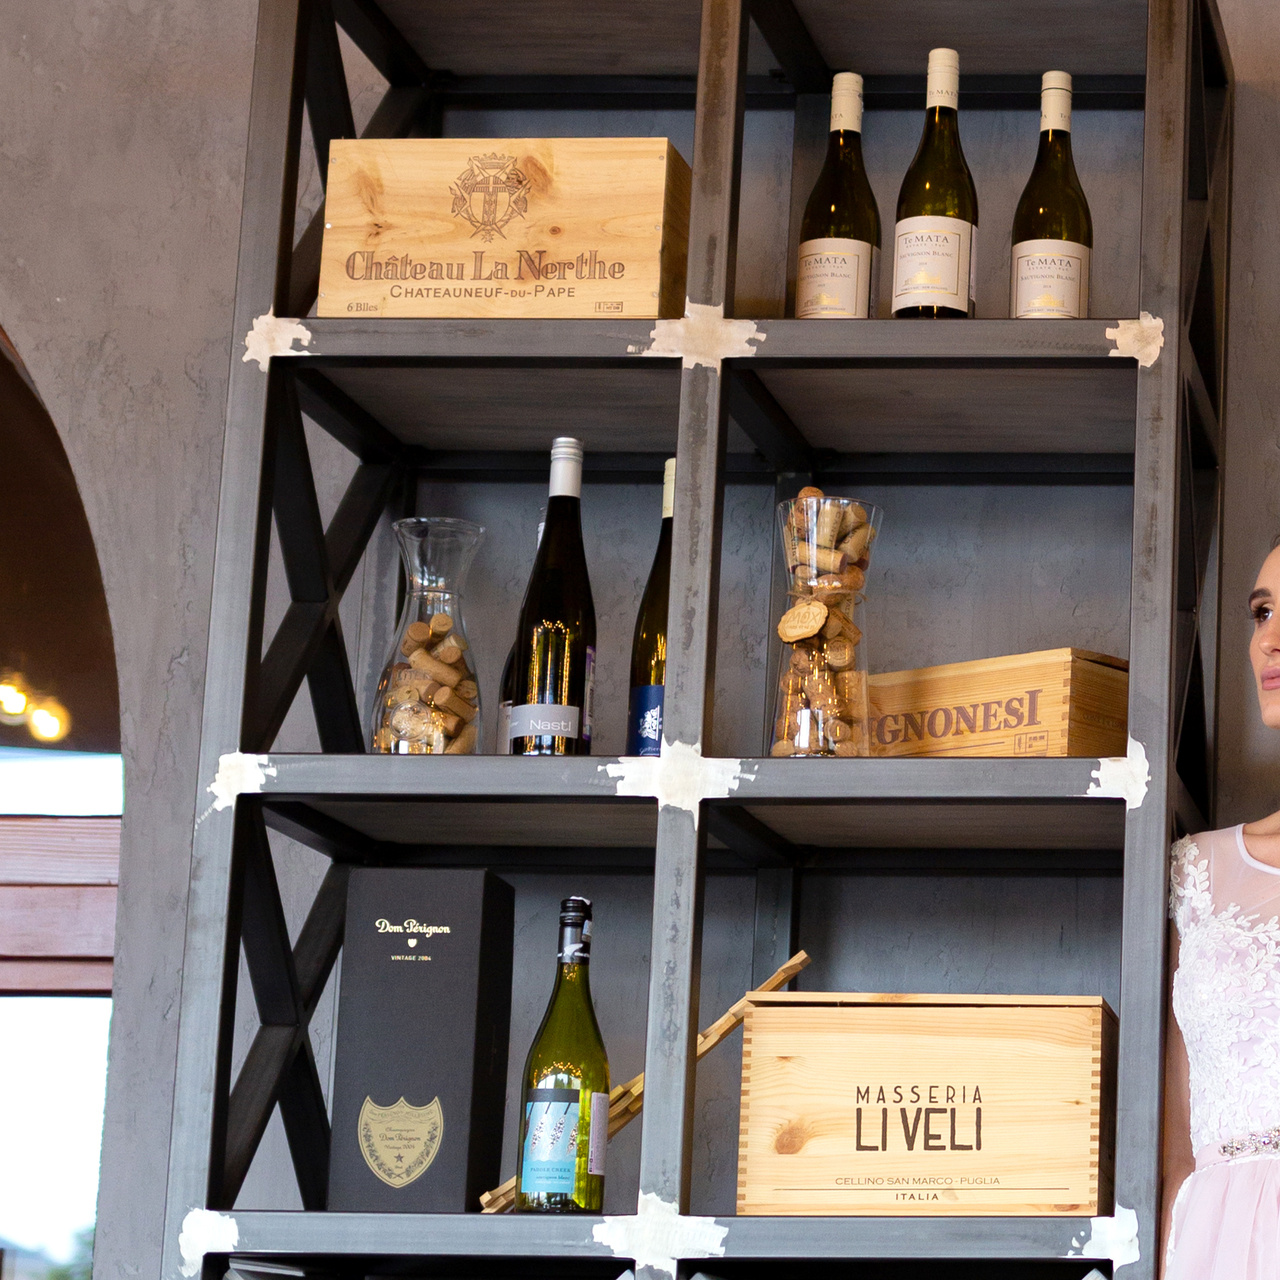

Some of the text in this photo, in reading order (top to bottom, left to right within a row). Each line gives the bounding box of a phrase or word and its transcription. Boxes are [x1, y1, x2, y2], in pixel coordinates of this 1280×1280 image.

[904, 235, 949, 245] Te MATA
[345, 249, 626, 281] Château La Nerthe
[804, 256, 847, 267] Te MATA
[1025, 258, 1072, 268] Te MATA
[346, 302, 354, 313] 6
[530, 719, 572, 732] Nastl
[375, 918, 451, 938] Dom Pérignon
[856, 1085, 982, 1104] MASSERIA
[856, 1107, 982, 1151] LI VELI
[379, 1132, 395, 1141] Dom
[835, 1177, 885, 1186] CELLINO
[886, 1177, 910, 1186] SAN
[912, 1177, 953, 1186] MARCO
[960, 1177, 1000, 1186] PUGLIA
[895, 1193, 939, 1201] ITALIA
